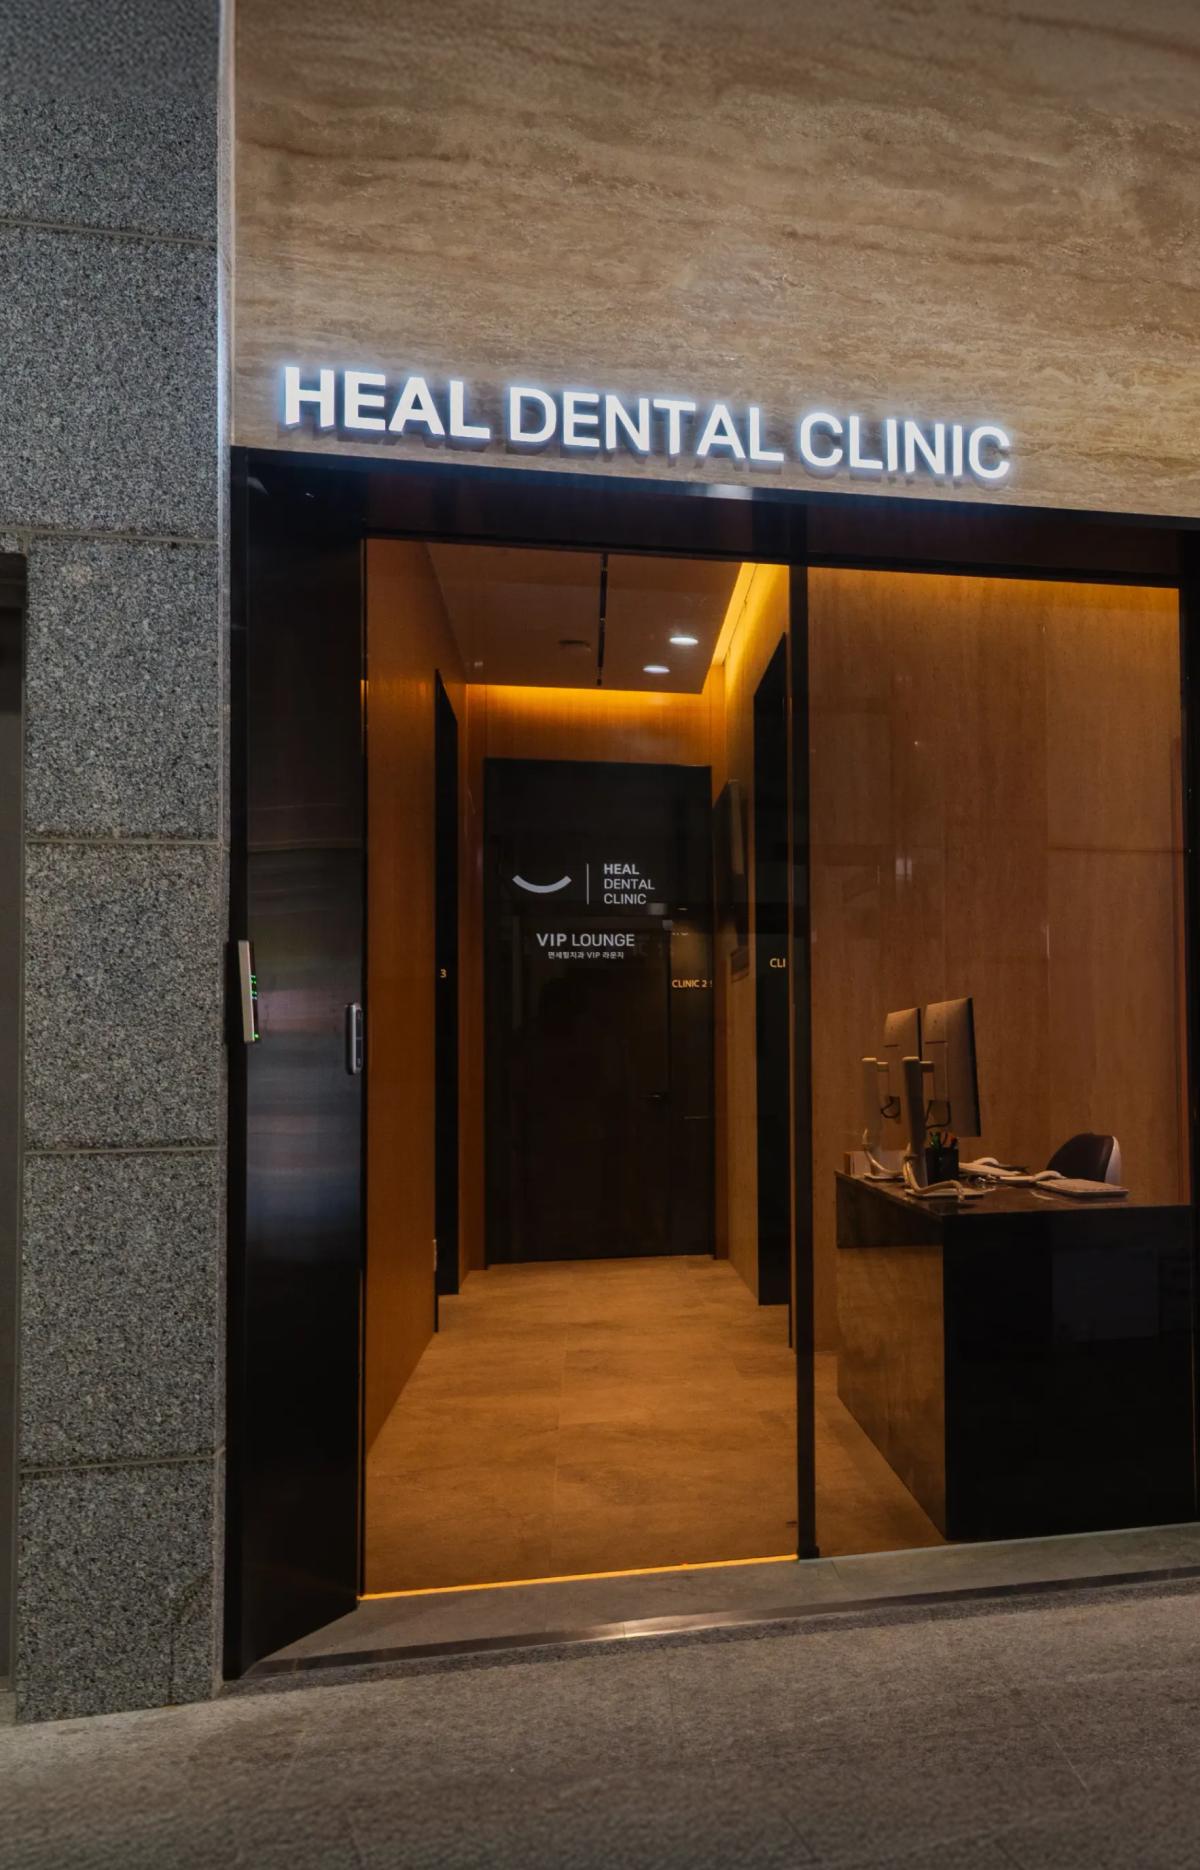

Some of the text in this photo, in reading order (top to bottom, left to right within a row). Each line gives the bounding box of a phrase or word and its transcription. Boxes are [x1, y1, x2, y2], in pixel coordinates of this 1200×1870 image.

[282, 364, 1012, 481] HEAL DENTAL CLINIC
[603, 863, 640, 875] HEAL
[603, 878, 656, 890] DENTAL
[603, 893, 647, 905] CLINIC
[536, 933, 636, 947] VIP LOUNGE
[586, 951, 601, 960] VIP
[671, 979, 700, 988] CLINIC
[701, 979, 707, 988] 2
